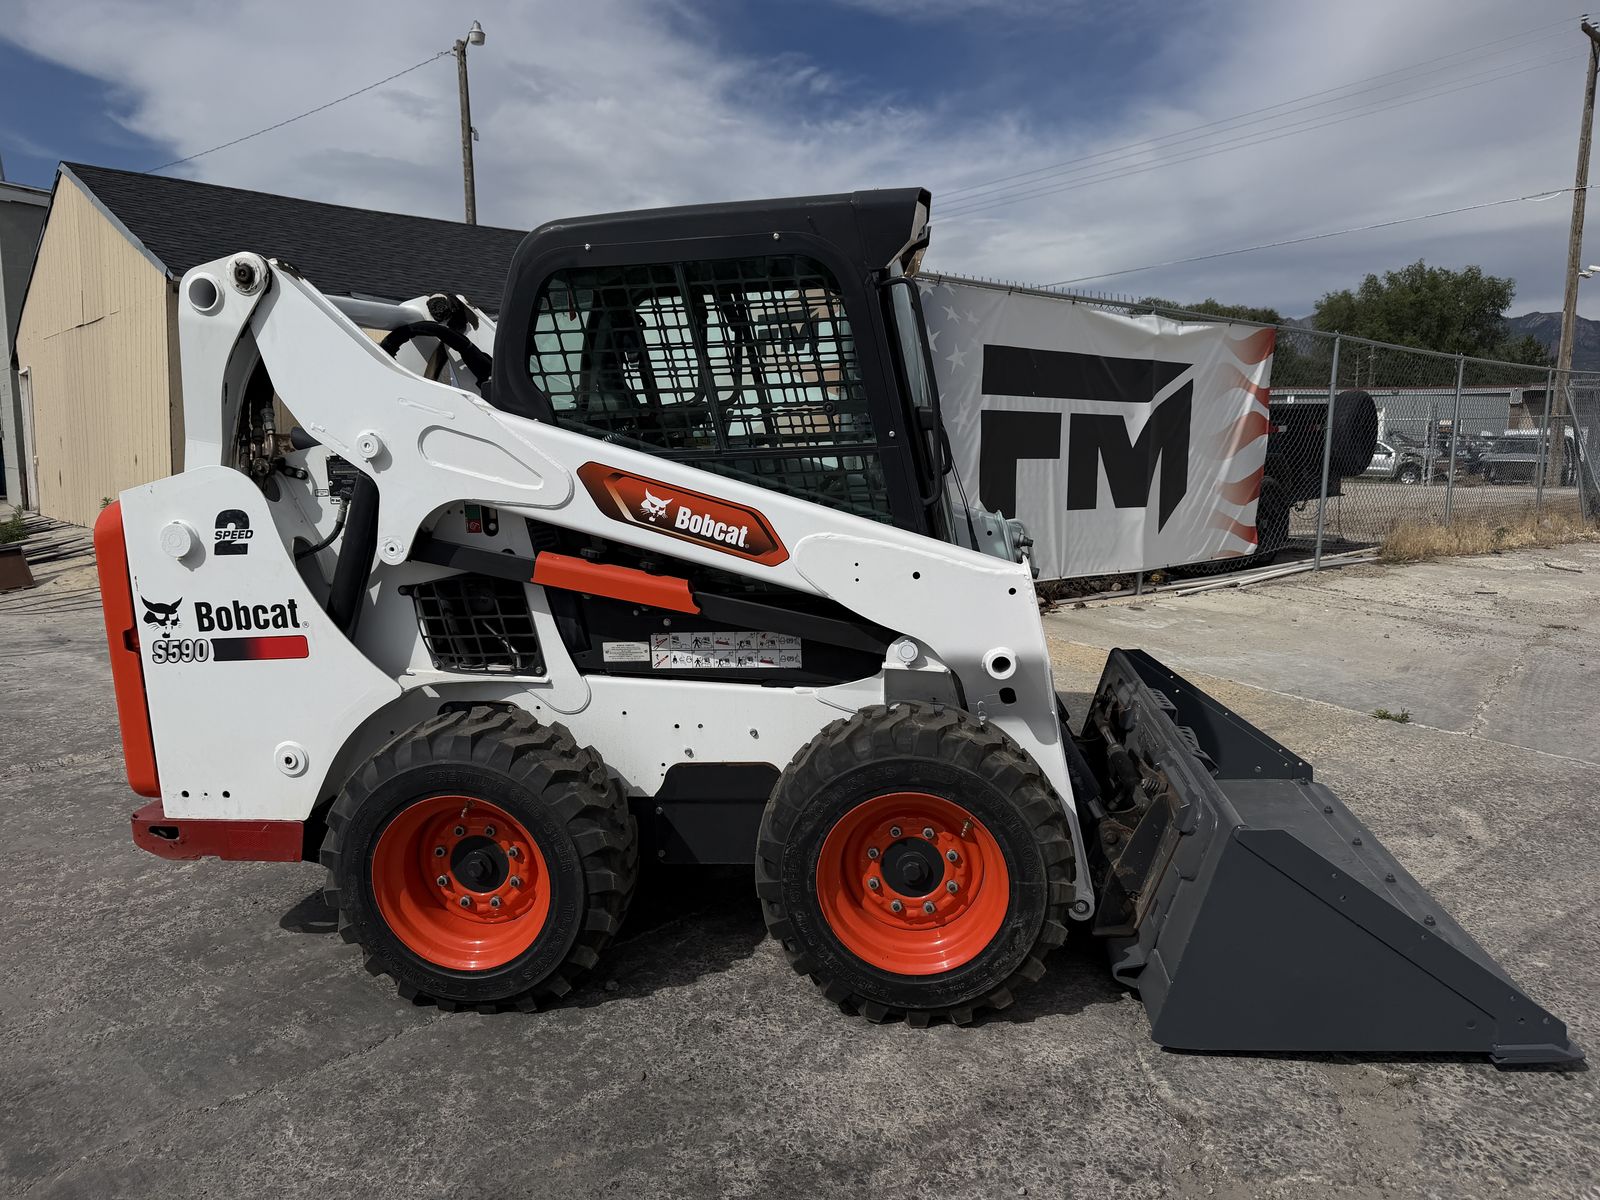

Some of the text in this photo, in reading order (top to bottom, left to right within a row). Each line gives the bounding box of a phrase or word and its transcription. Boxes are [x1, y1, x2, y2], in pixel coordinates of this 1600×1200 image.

[979, 344, 1194, 534] FM
[214, 509, 254, 555] 2 SPEED
[674, 505, 748, 549] Bobcat
[194, 598, 304, 632] Bobcat
[152, 638, 209, 664] S590
